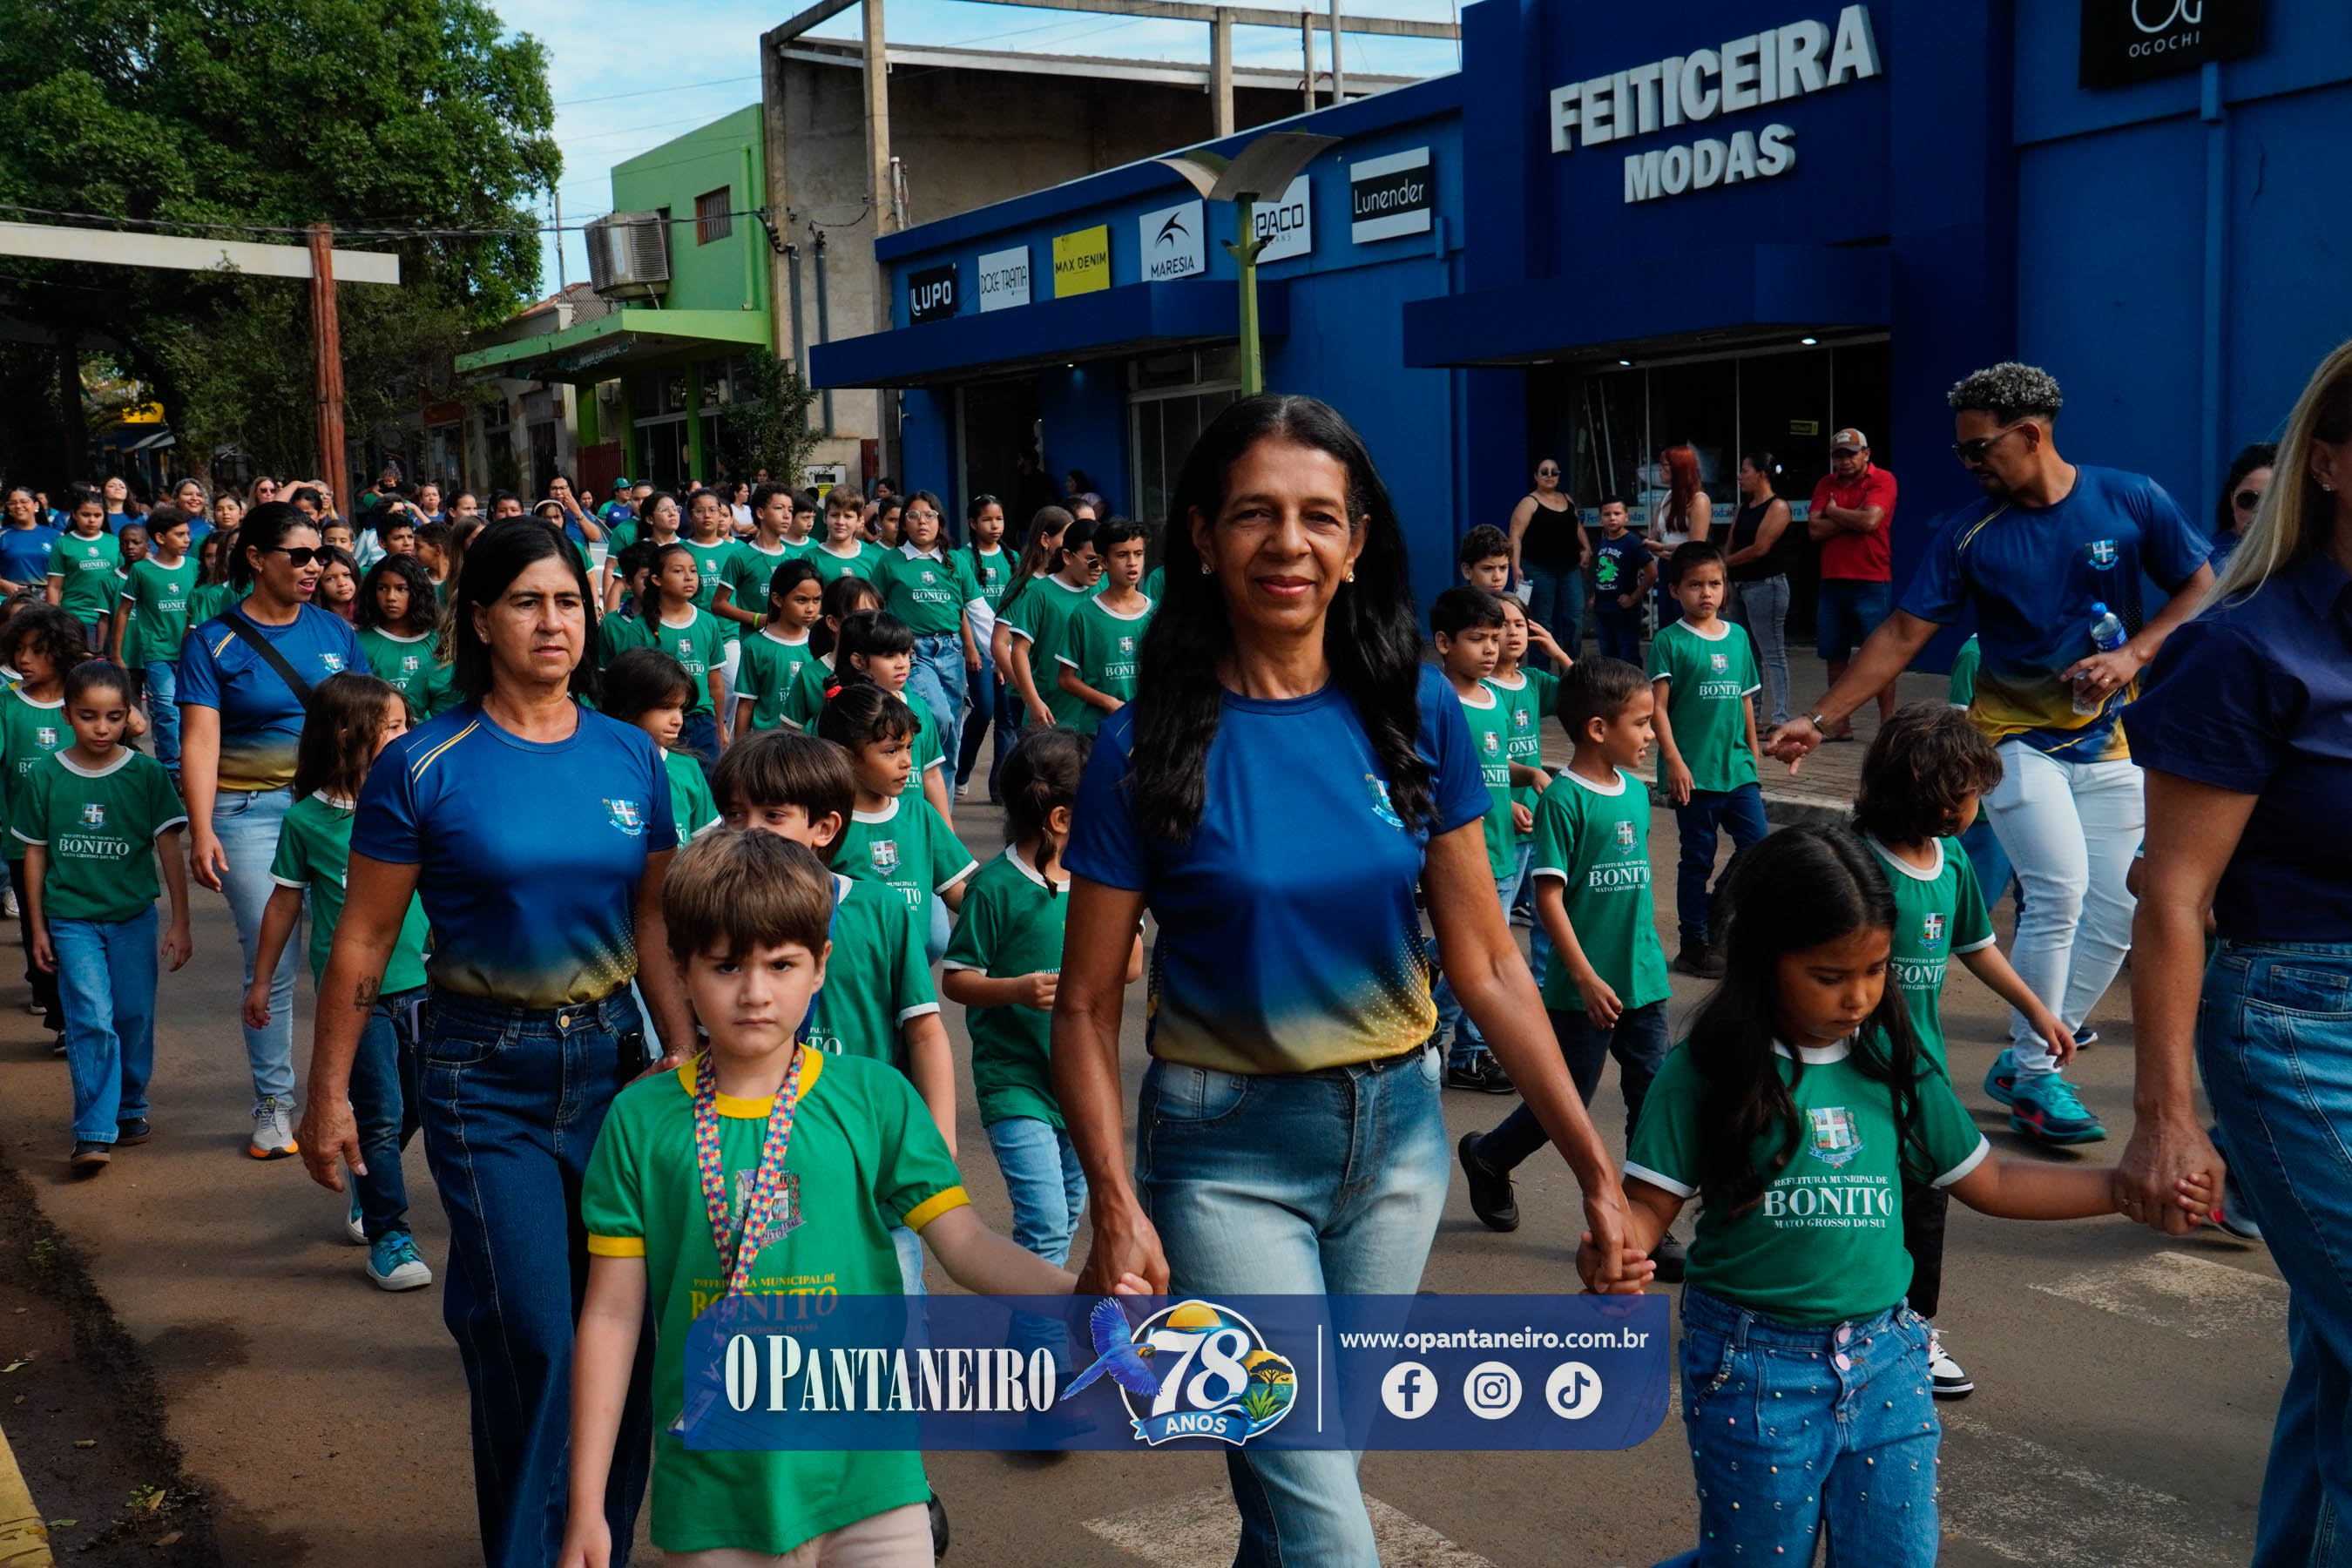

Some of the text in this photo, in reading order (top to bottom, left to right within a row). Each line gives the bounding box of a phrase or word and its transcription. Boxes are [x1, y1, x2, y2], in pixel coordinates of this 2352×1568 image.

[2128, 30, 2200, 57] OGOCHI
[1550, 3, 1882, 154] FEITICEIRA
[1624, 124, 1796, 203] MODAS
[1354, 179, 1424, 214] Lunender
[1255, 204, 1304, 238] PACO
[1055, 252, 1107, 274] MAX DENIM
[1151, 255, 1195, 278] MARESIA
[981, 265, 1027, 294] DOCE TRAMA
[910, 280, 952, 316] LUPO
[79, 561, 110, 570] BONITO
[158, 601, 186, 611] BONIT
[912, 591, 951, 601] BONITO
[1105, 664, 1136, 677] BONI
[58, 838, 130, 856] BONITO
[1588, 866, 1650, 887] BONITO
[1774, 1175, 1889, 1187] REFEITURA MUNICIPAL DE
[1762, 1186, 1893, 1217] BONITO
[1774, 1219, 1804, 1229] MATO
[1807, 1218, 1850, 1227] GROSSO
[1853, 1219, 1868, 1227] DO
[760, 1274, 824, 1287] MUNICIPAL
[824, 1273, 836, 1283] DE
